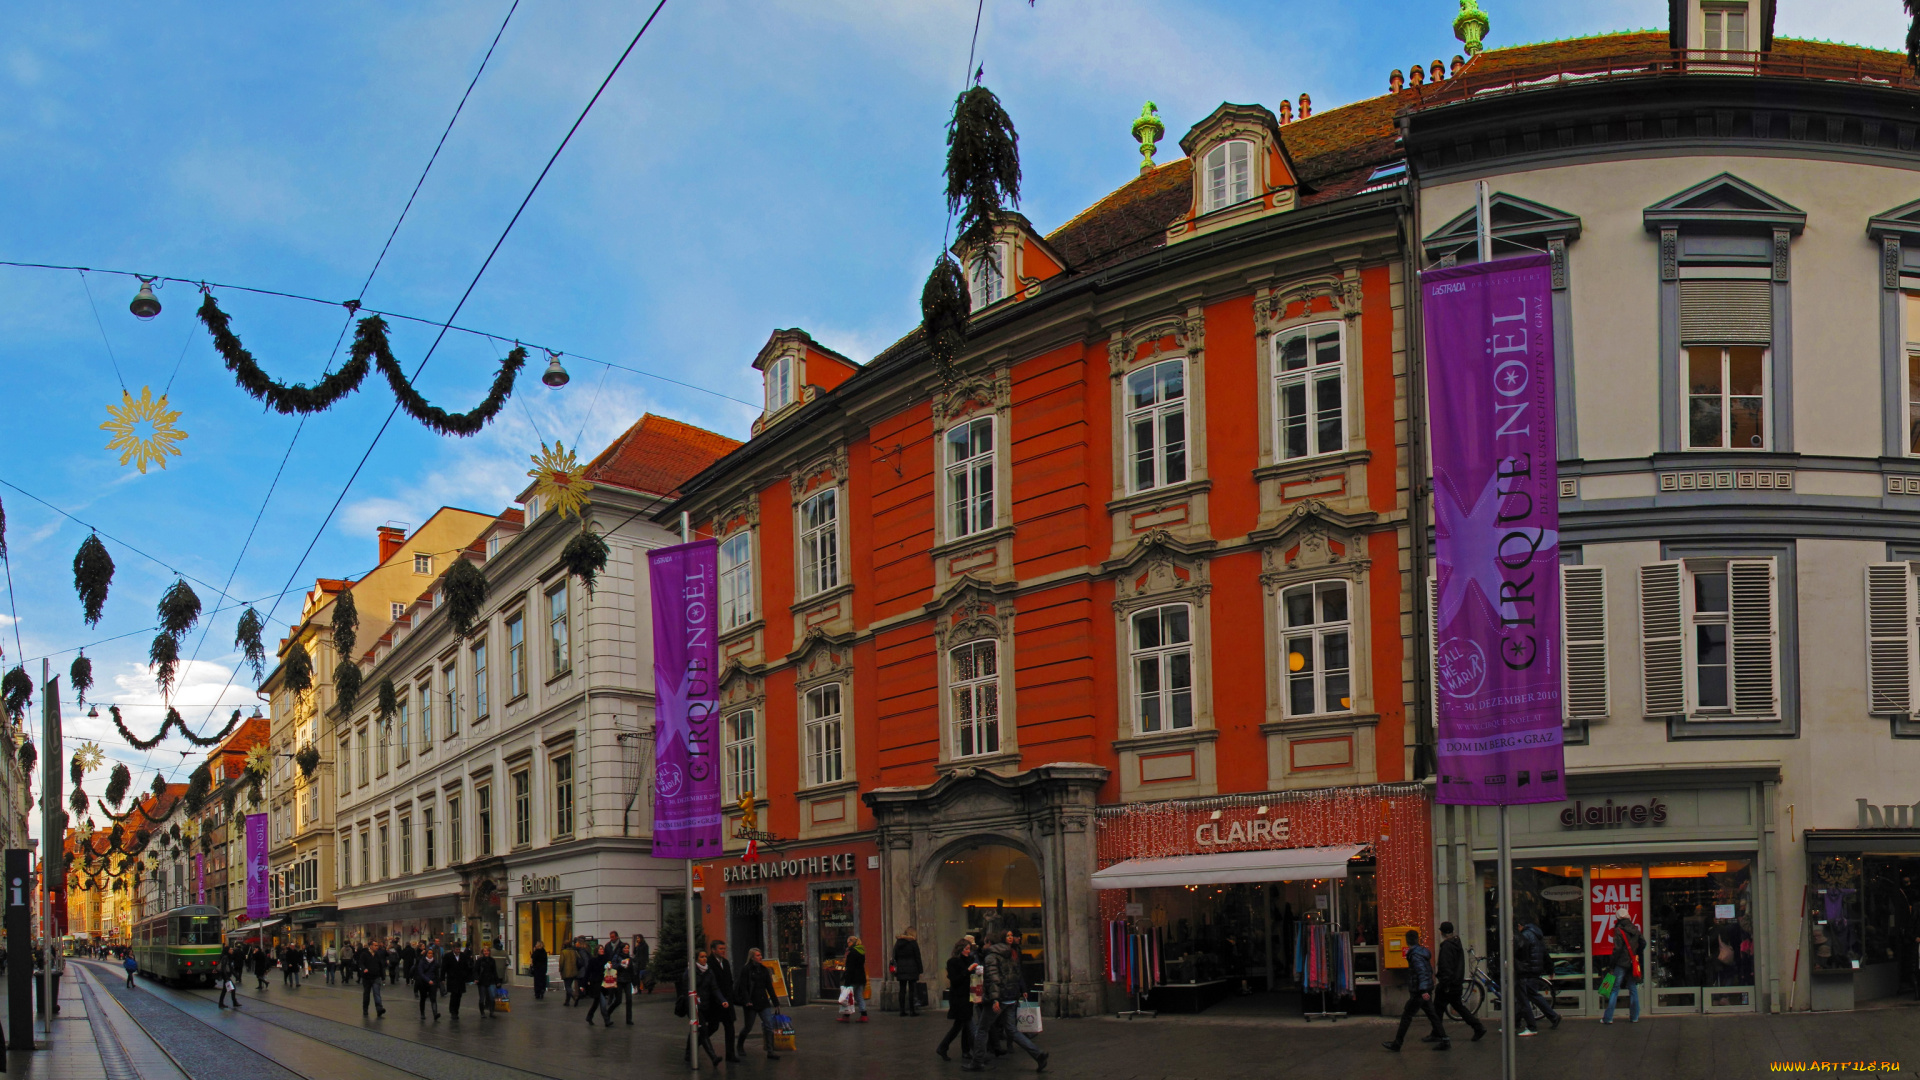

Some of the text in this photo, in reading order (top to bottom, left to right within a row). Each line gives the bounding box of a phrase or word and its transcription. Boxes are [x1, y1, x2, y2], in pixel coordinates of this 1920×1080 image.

[1533, 295, 1543, 328] GRAZ
[1535, 332, 1544, 348] IN
[1485, 296, 1544, 670] CIRQUE NOËL
[1540, 494, 1549, 515] DIE
[682, 563, 707, 649] NOËL
[1438, 647, 1464, 667] CALL
[1441, 664, 1458, 680] ME
[1463, 702, 1478, 712] 30.
[1479, 692, 1535, 710] DEZEMBER
[1537, 690, 1558, 701] 2010
[687, 657, 715, 782] CIRQUE
[1446, 732, 1554, 752] DOM IM BERG GRAZ
[1560, 798, 1667, 826] claire's
[736, 828, 777, 840] APOTHEKE
[1196, 807, 1290, 846] CLAIRE
[1592, 884, 1641, 904] SALE
[1604, 904, 1617, 913] BIS
